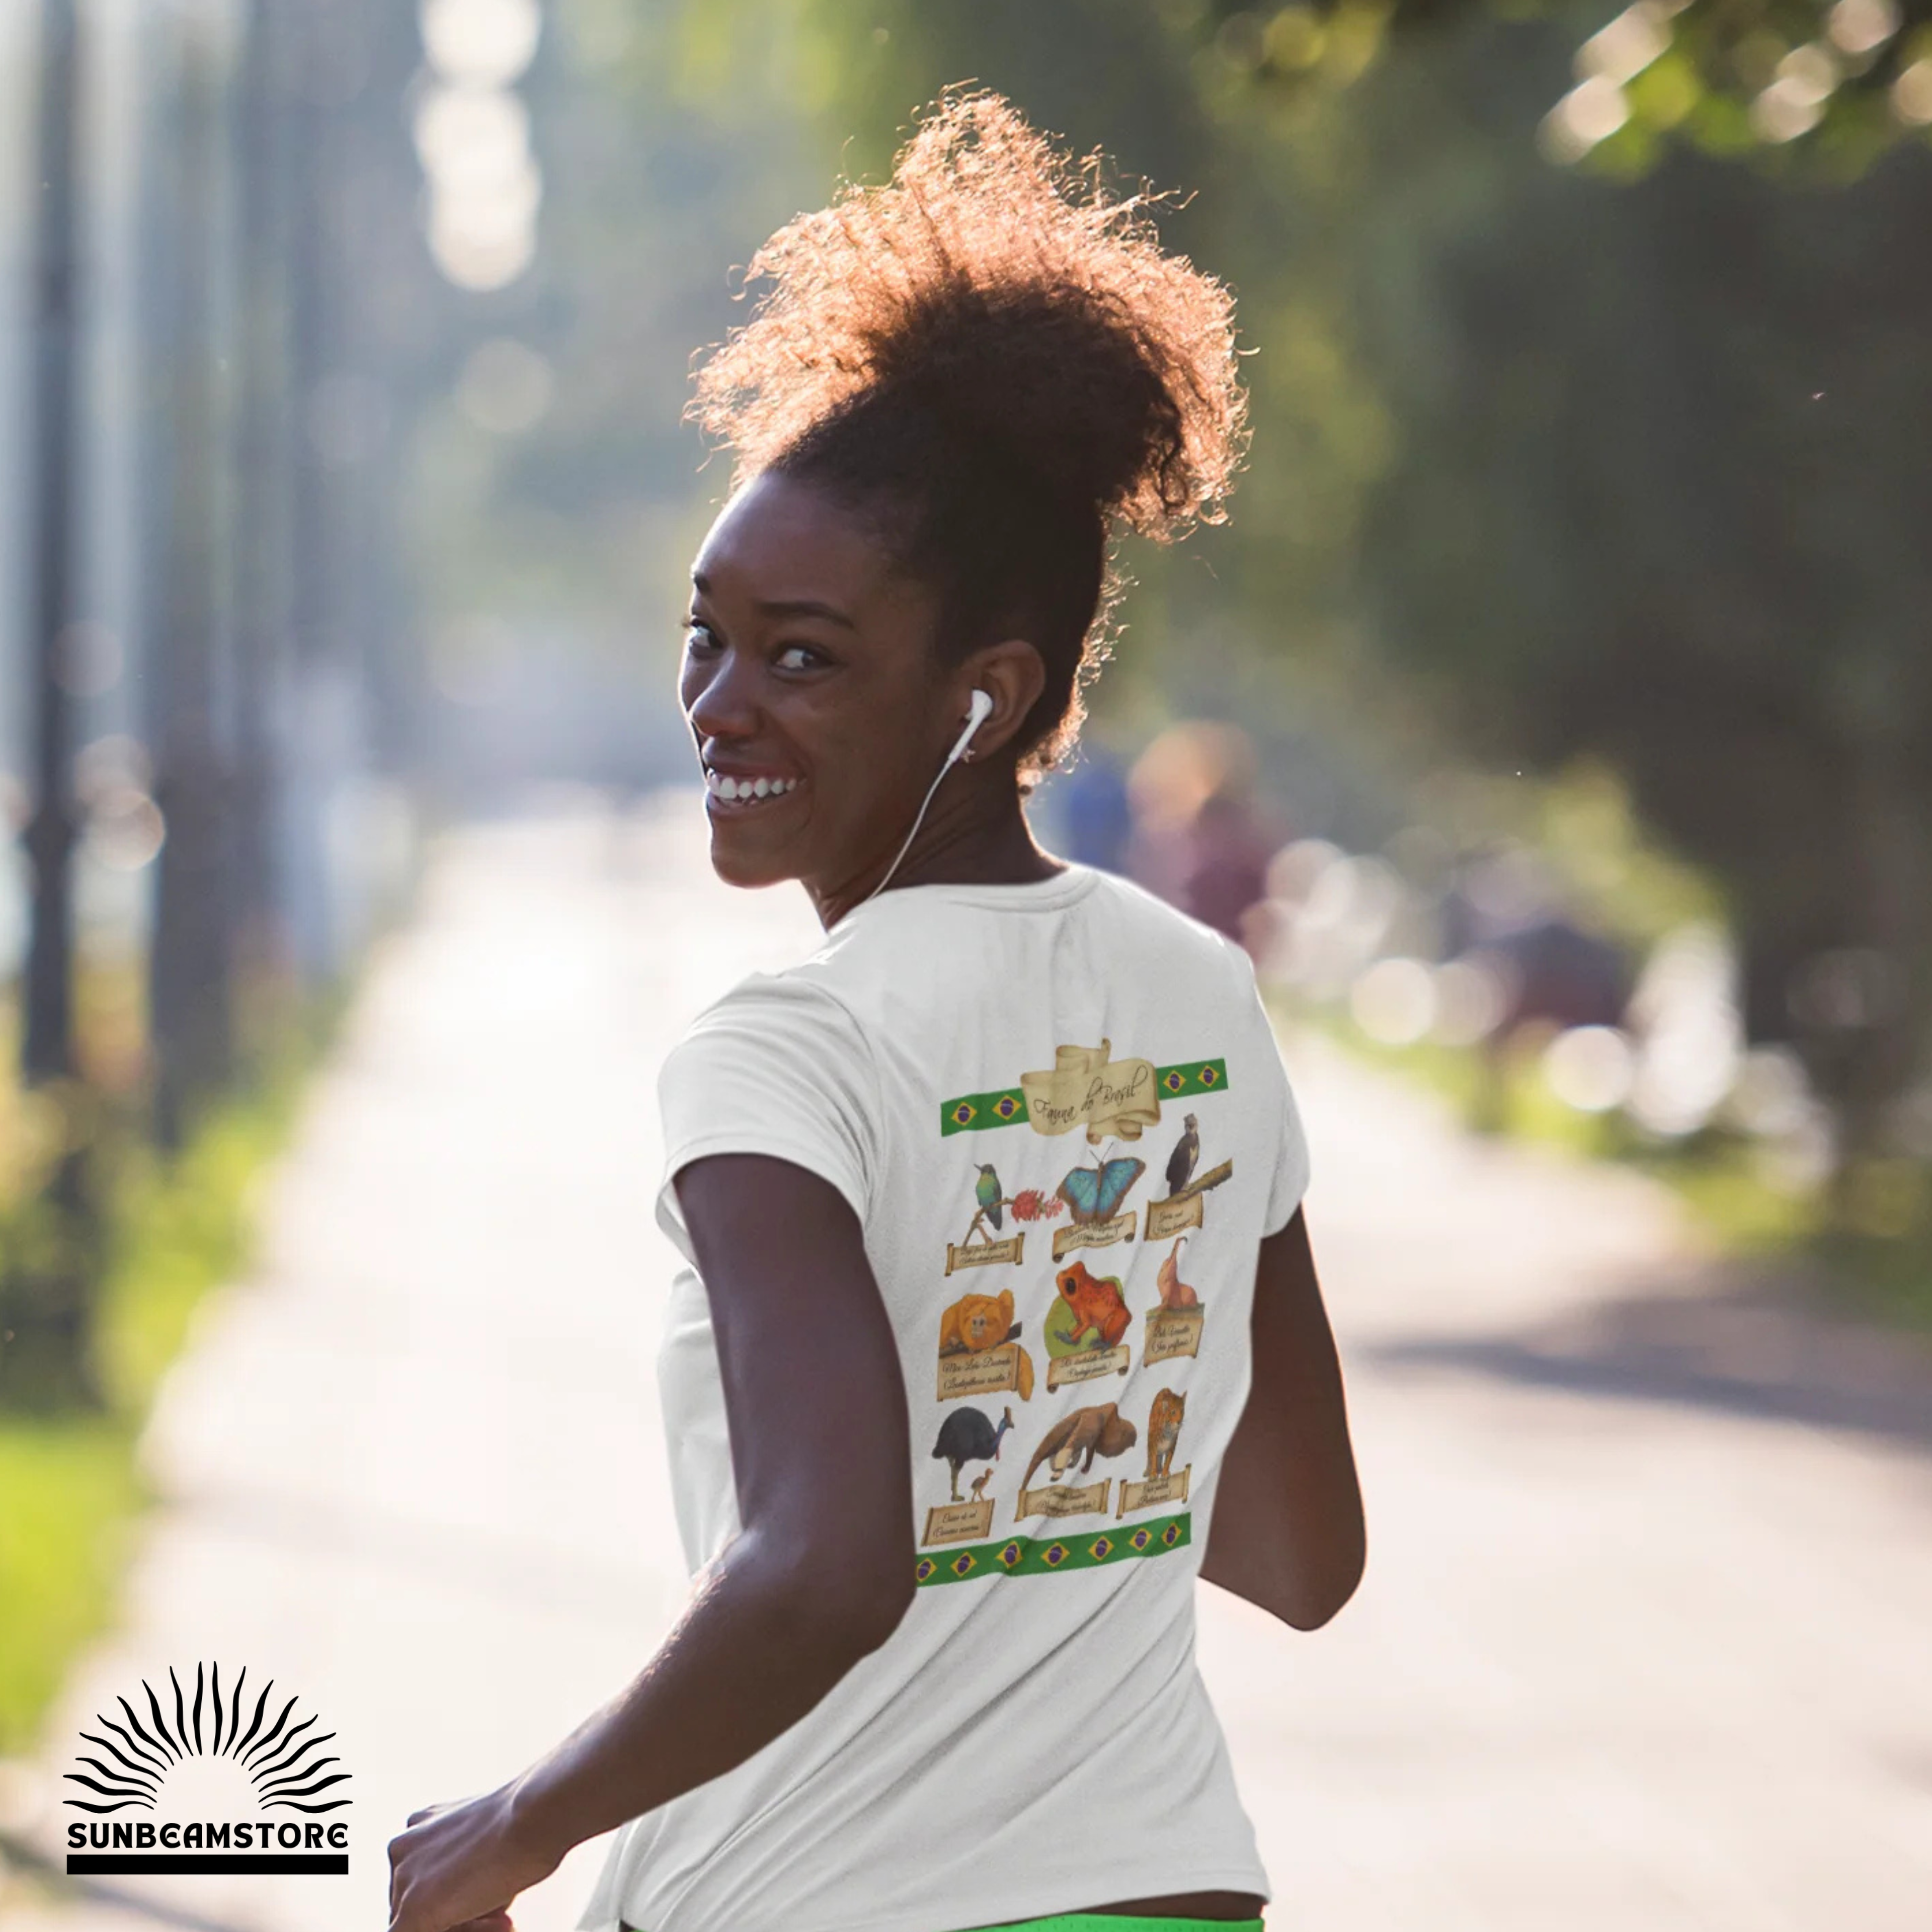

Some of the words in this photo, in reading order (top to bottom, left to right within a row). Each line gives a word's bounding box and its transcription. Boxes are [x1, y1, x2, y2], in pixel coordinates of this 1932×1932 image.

[1033, 1098, 1077, 1125] Fauna
[1080, 1076, 1103, 1111] do
[1101, 1064, 1148, 1106] Brasil
